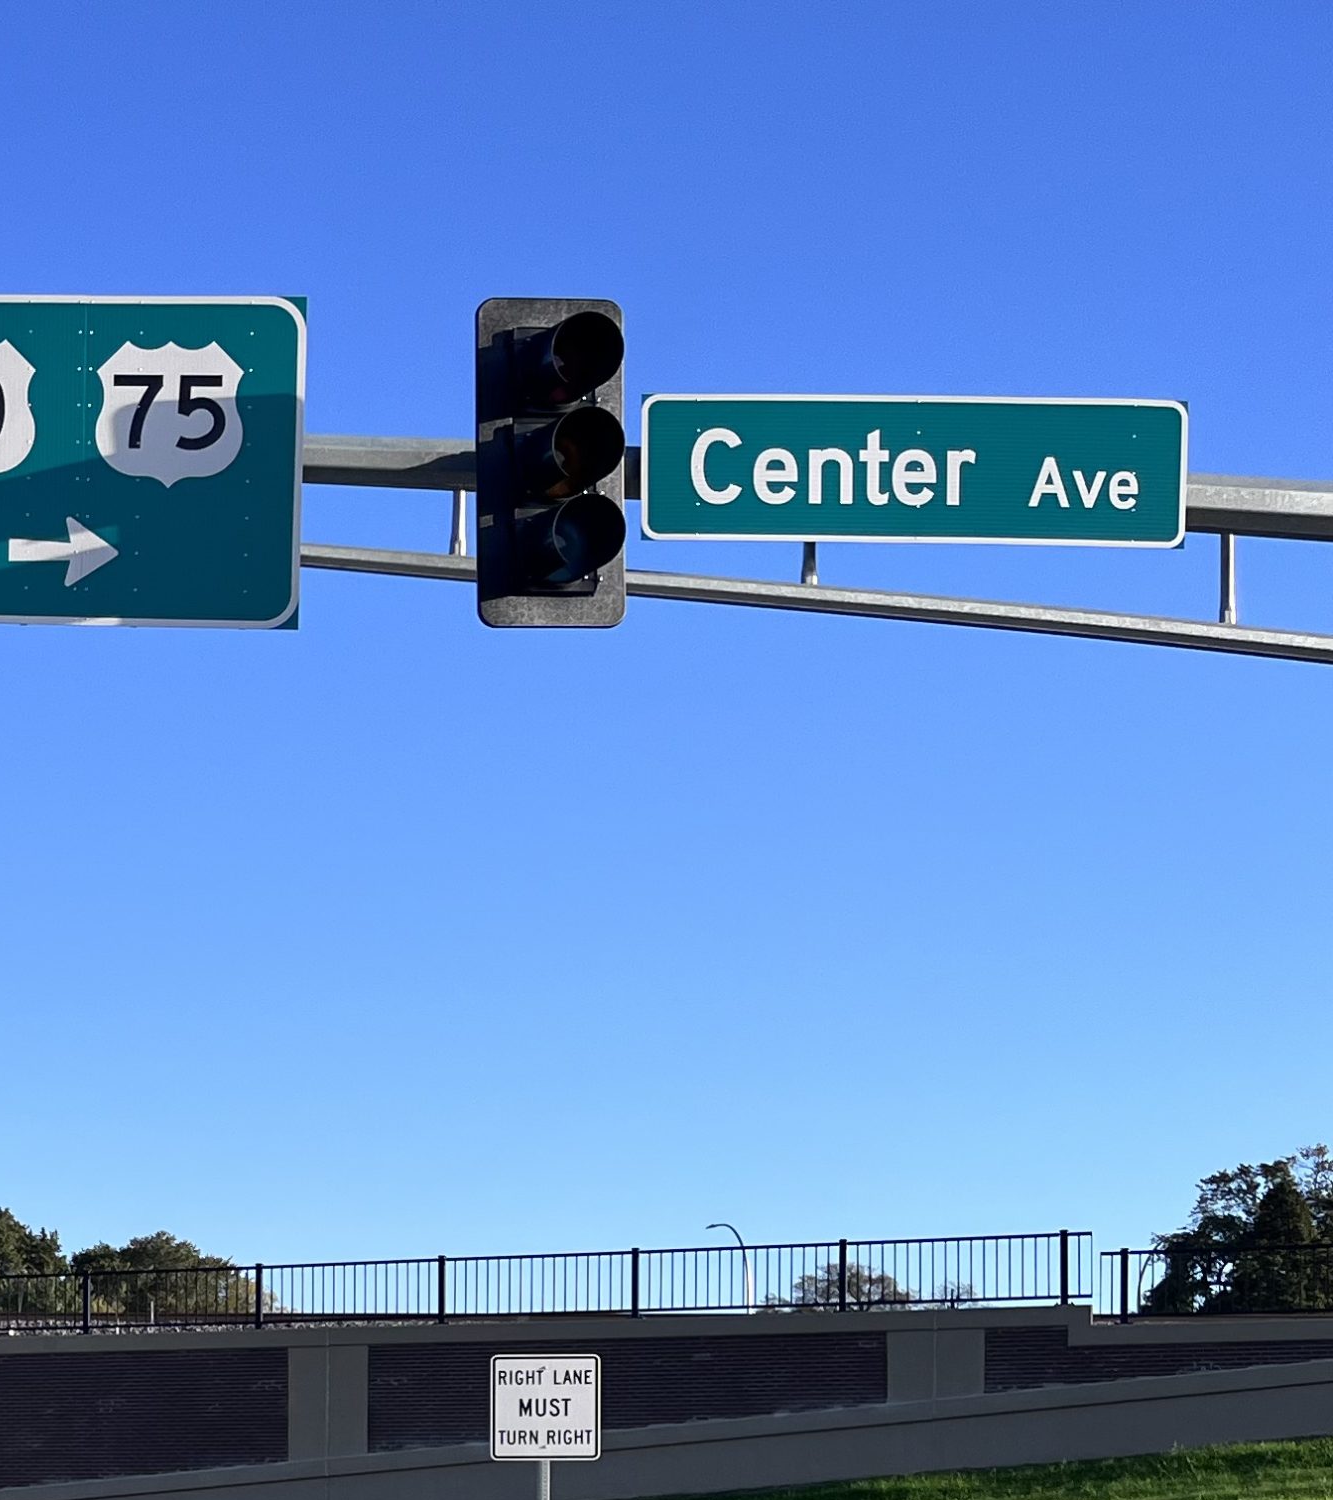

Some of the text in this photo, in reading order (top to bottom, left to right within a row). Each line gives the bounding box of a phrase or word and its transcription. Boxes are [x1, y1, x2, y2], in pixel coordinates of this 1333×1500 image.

[112, 373, 227, 451] 75
[689, 426, 1140, 511] Center Ave
[497, 1369, 593, 1386] RIGHT LANE
[519, 1398, 572, 1417] MUST
[497, 1429, 593, 1445] TURN RIGHT
